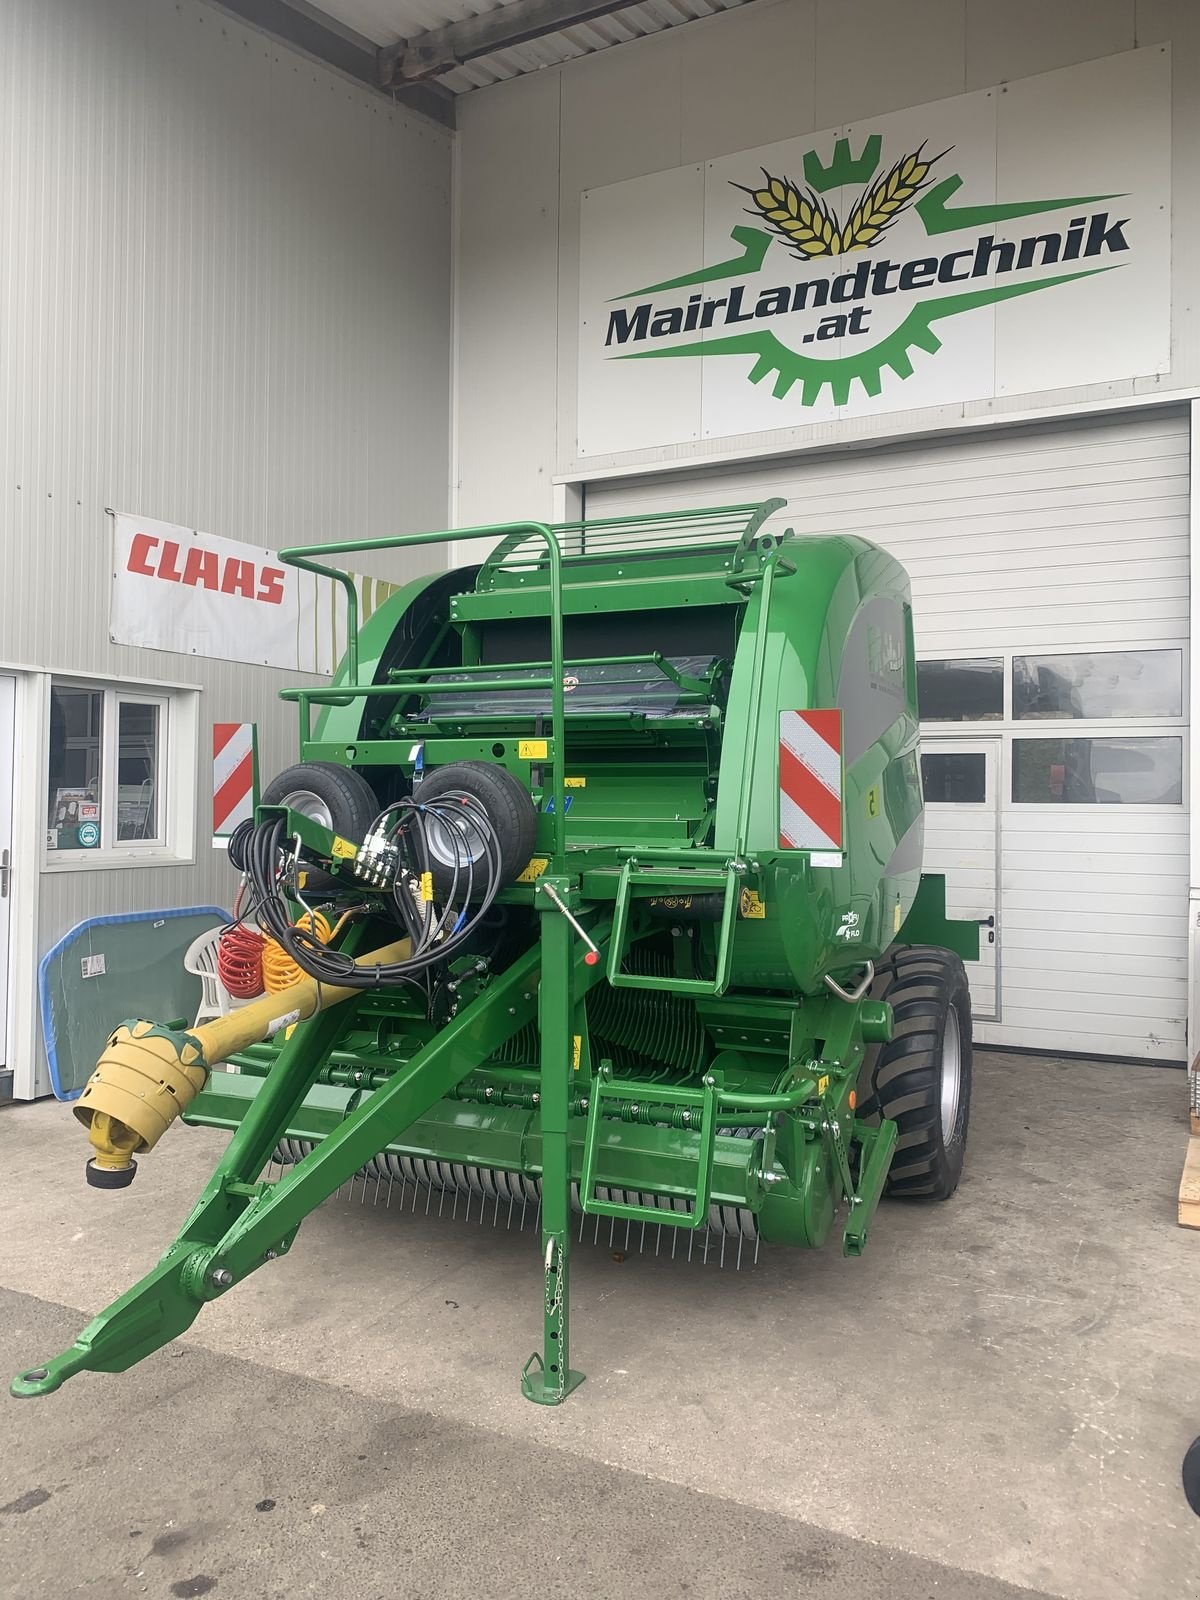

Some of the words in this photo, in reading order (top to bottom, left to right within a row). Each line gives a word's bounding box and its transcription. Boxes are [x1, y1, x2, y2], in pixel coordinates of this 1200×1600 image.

[604, 212, 1132, 347] MairLandtechnik
[802, 306, 872, 344] .at
[126, 533, 286, 605] CLAAS
